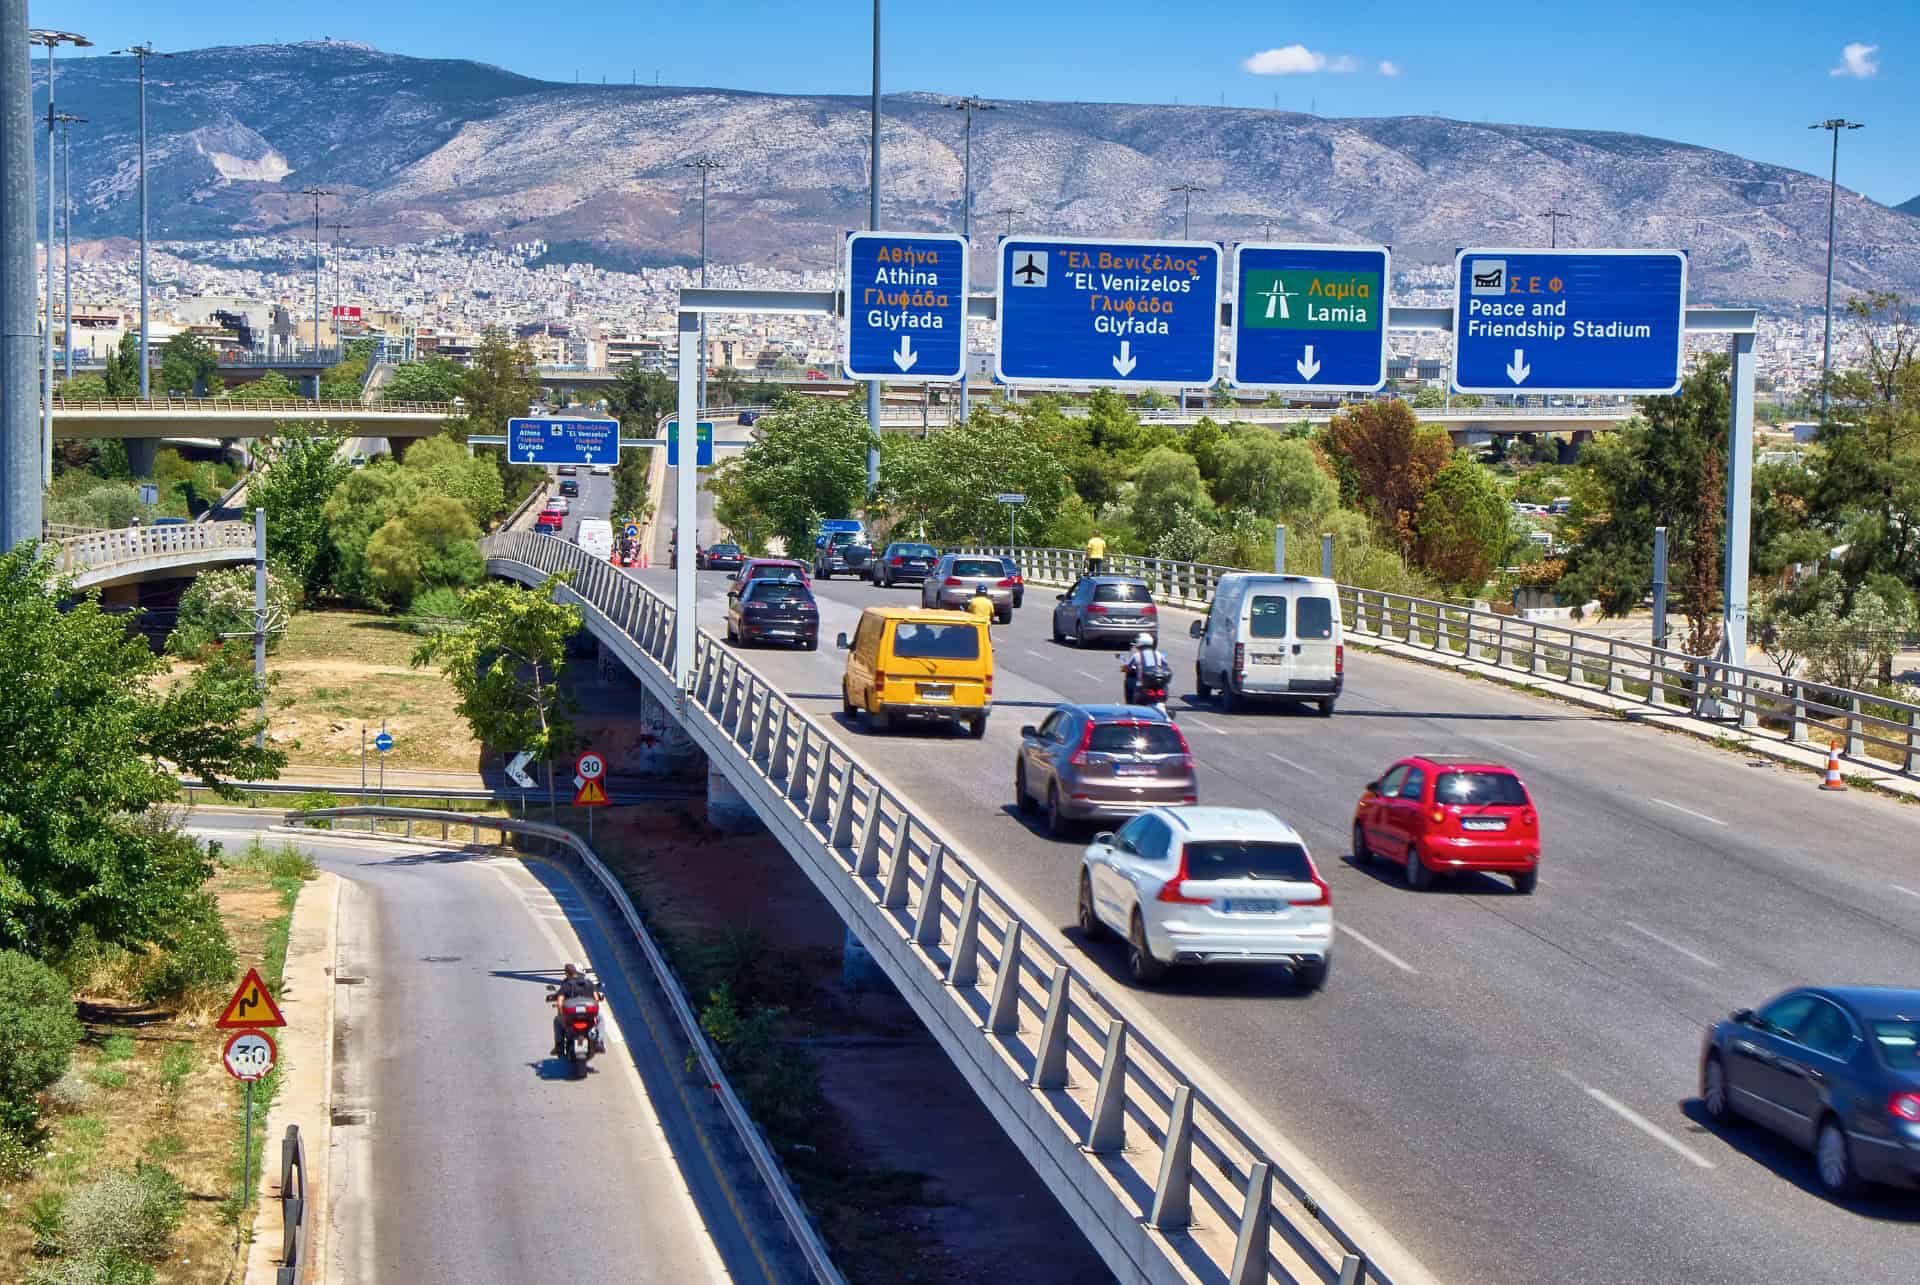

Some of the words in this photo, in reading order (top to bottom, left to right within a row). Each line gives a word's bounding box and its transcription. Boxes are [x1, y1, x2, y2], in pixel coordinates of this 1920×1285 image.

[877, 246, 938, 267] Αθήνα
[875, 267, 938, 286] Athina
[863, 287, 948, 311] Γλυφάδα
[1308, 278, 1369, 300] Λαμία
[1090, 294, 1173, 316] Γλυφάδα
[1307, 303, 1367, 323] Lamia
[1469, 299, 1525, 317] Peace
[1531, 299, 1566, 317] and
[867, 309, 943, 331] Glyfada
[1094, 315, 1169, 337] Glyfada
[1468, 320, 1565, 341] Friendship
[1573, 321, 1651, 338] Stadium
[582, 761, 600, 773] 30
